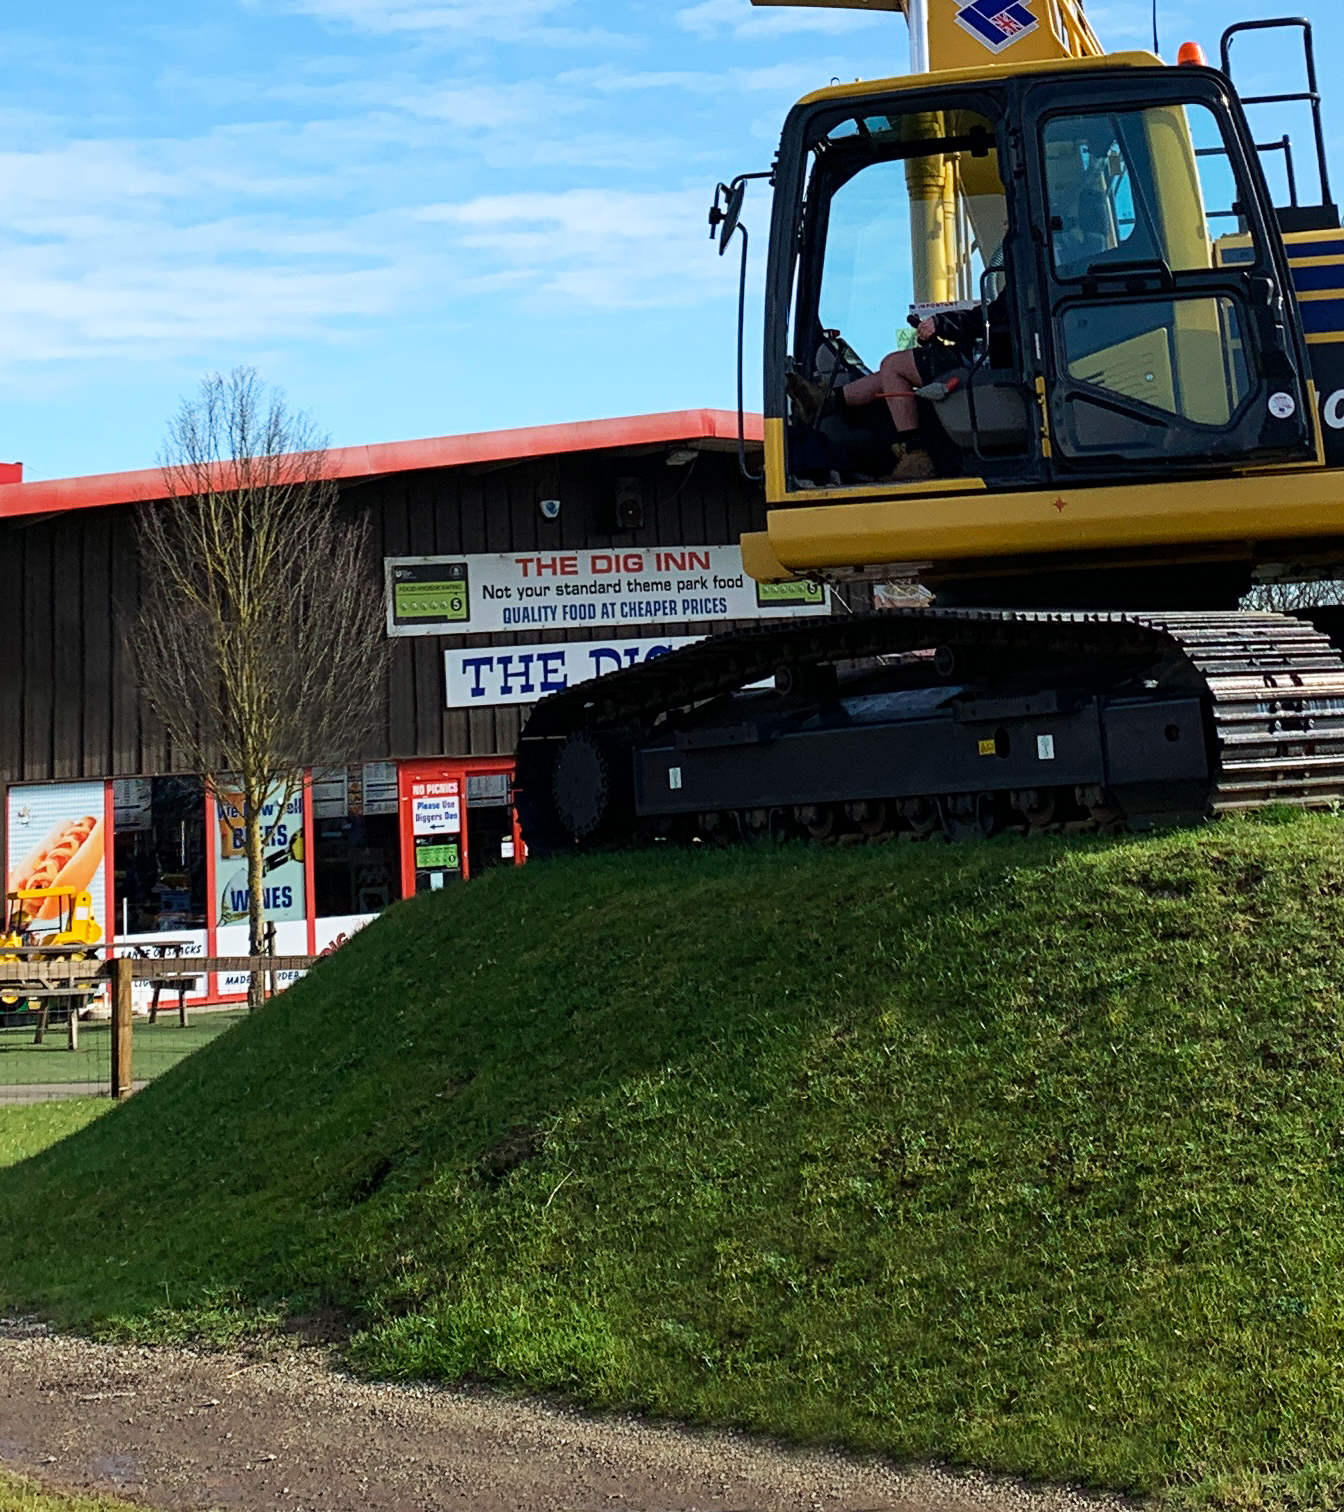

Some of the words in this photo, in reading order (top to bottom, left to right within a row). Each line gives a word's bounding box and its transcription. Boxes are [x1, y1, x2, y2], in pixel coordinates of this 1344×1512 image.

[515, 556, 579, 577] THE
[591, 553, 644, 574] DIG
[656, 551, 710, 571] INN
[483, 584, 512, 600] Not
[517, 585, 550, 601] your
[556, 580, 622, 596] standard
[627, 579, 672, 594] theme
[677, 577, 708, 593] park
[713, 575, 744, 589] food
[452, 598, 460, 610] 5
[503, 605, 558, 624] QUALITY
[562, 603, 596, 621] FOOD
[601, 602, 616, 619] AT
[620, 599, 678, 618] CHEAPER
[682, 597, 728, 615] PRICES
[462, 651, 567, 698] THE
[412, 784, 425, 795] NO
[427, 782, 458, 795] PICNICS
[416, 813, 442, 823] Diggers
[445, 811, 457, 820] Den
[417, 801, 440, 810] Please
[442, 800, 455, 808] Use
[233, 824, 288, 849] BRS
[231, 886, 293, 912] WNES
